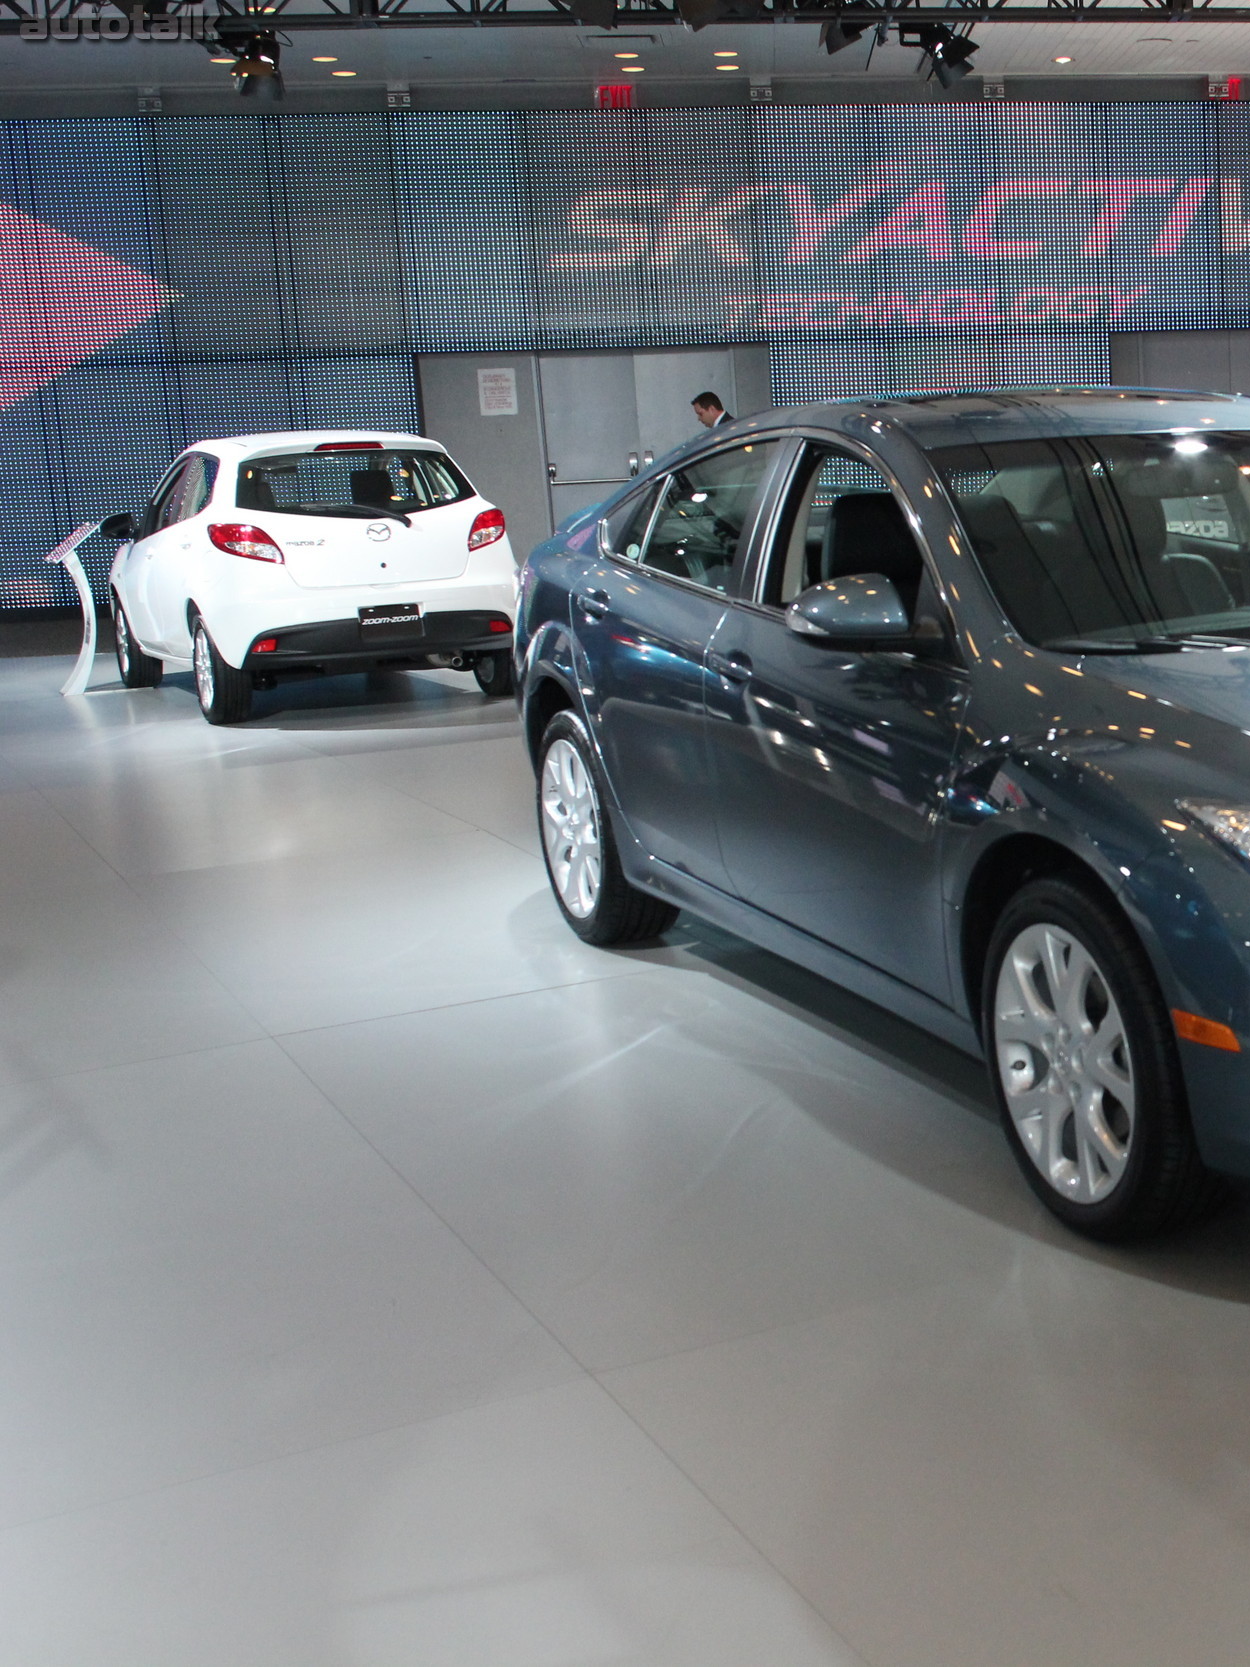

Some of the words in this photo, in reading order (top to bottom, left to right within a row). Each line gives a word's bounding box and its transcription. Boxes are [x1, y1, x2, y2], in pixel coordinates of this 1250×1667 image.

[598, 85, 632, 108] EXIT
[720, 281, 1146, 332] TECHNOLOGY
[1166, 520, 1229, 538] azda
[361, 614, 419, 626] zoom-zoom
